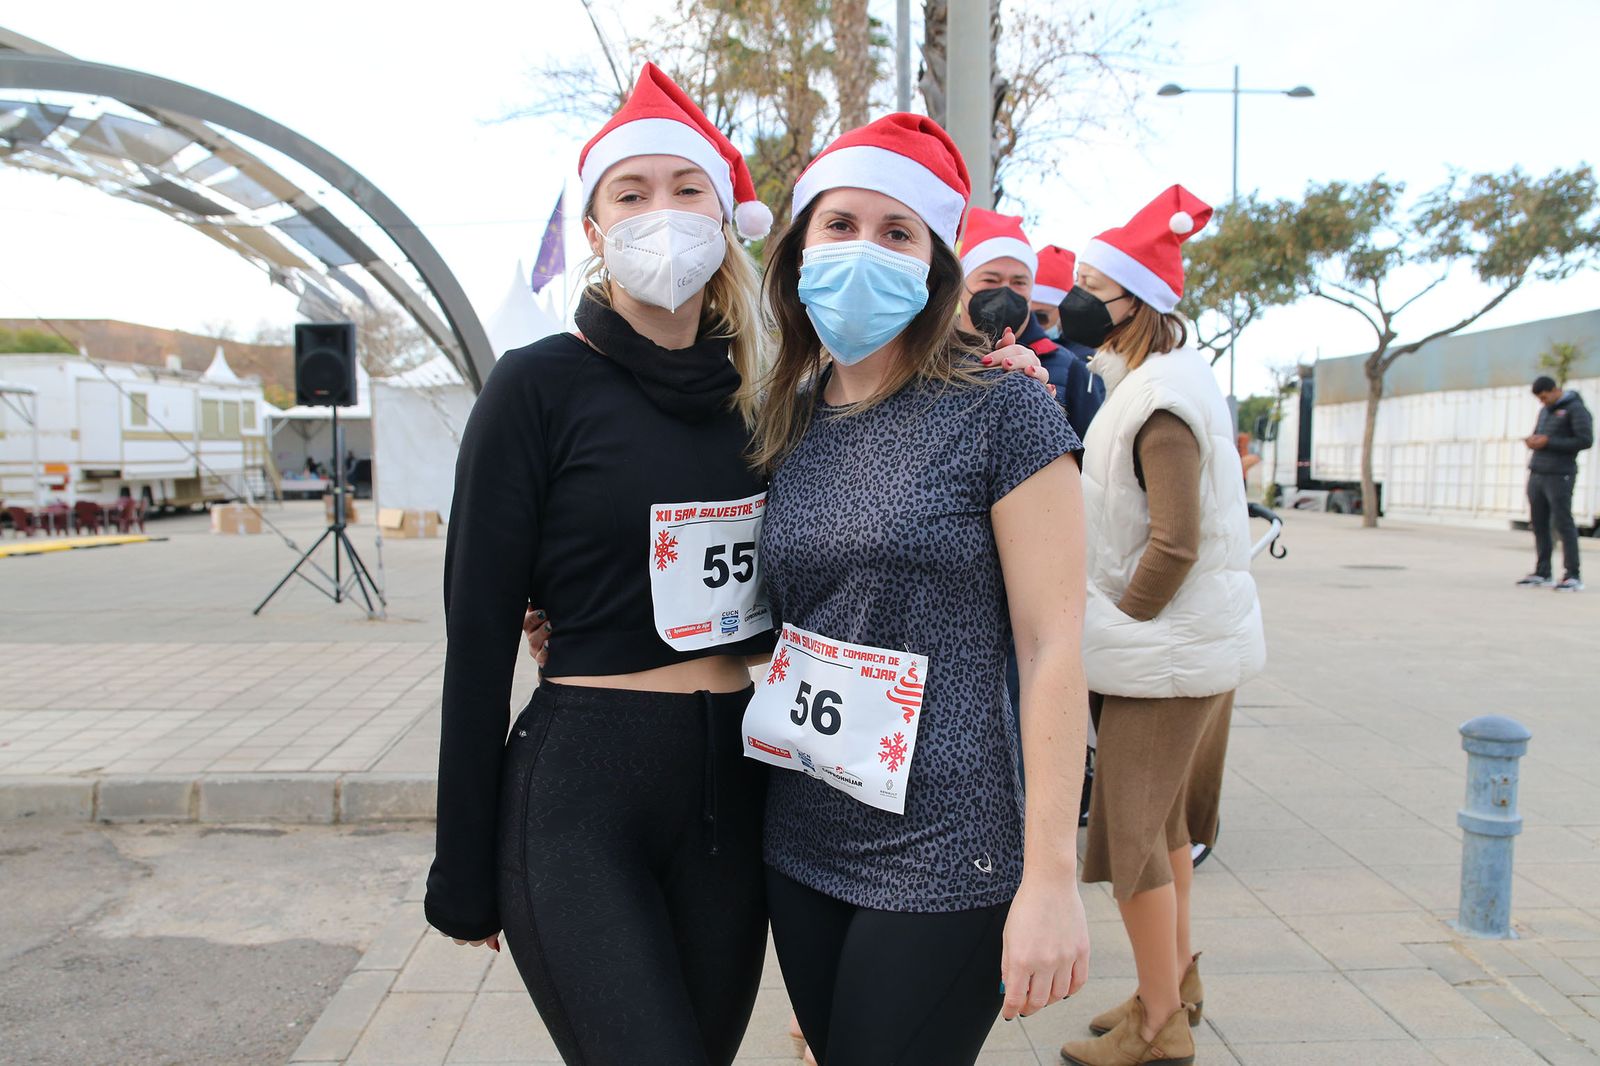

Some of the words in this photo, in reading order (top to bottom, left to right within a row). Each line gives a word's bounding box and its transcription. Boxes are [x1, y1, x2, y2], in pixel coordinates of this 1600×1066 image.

[656, 510, 672, 522] XII
[675, 508, 697, 521] SAN
[699, 503, 753, 518] SILVESTRE
[703, 541, 755, 589] 55
[802, 636, 839, 659] SILVESTRE
[843, 648, 886, 664] COMARCA
[888, 656, 900, 666] DE
[860, 664, 897, 682] NÍJAR
[790, 680, 843, 736] 56
